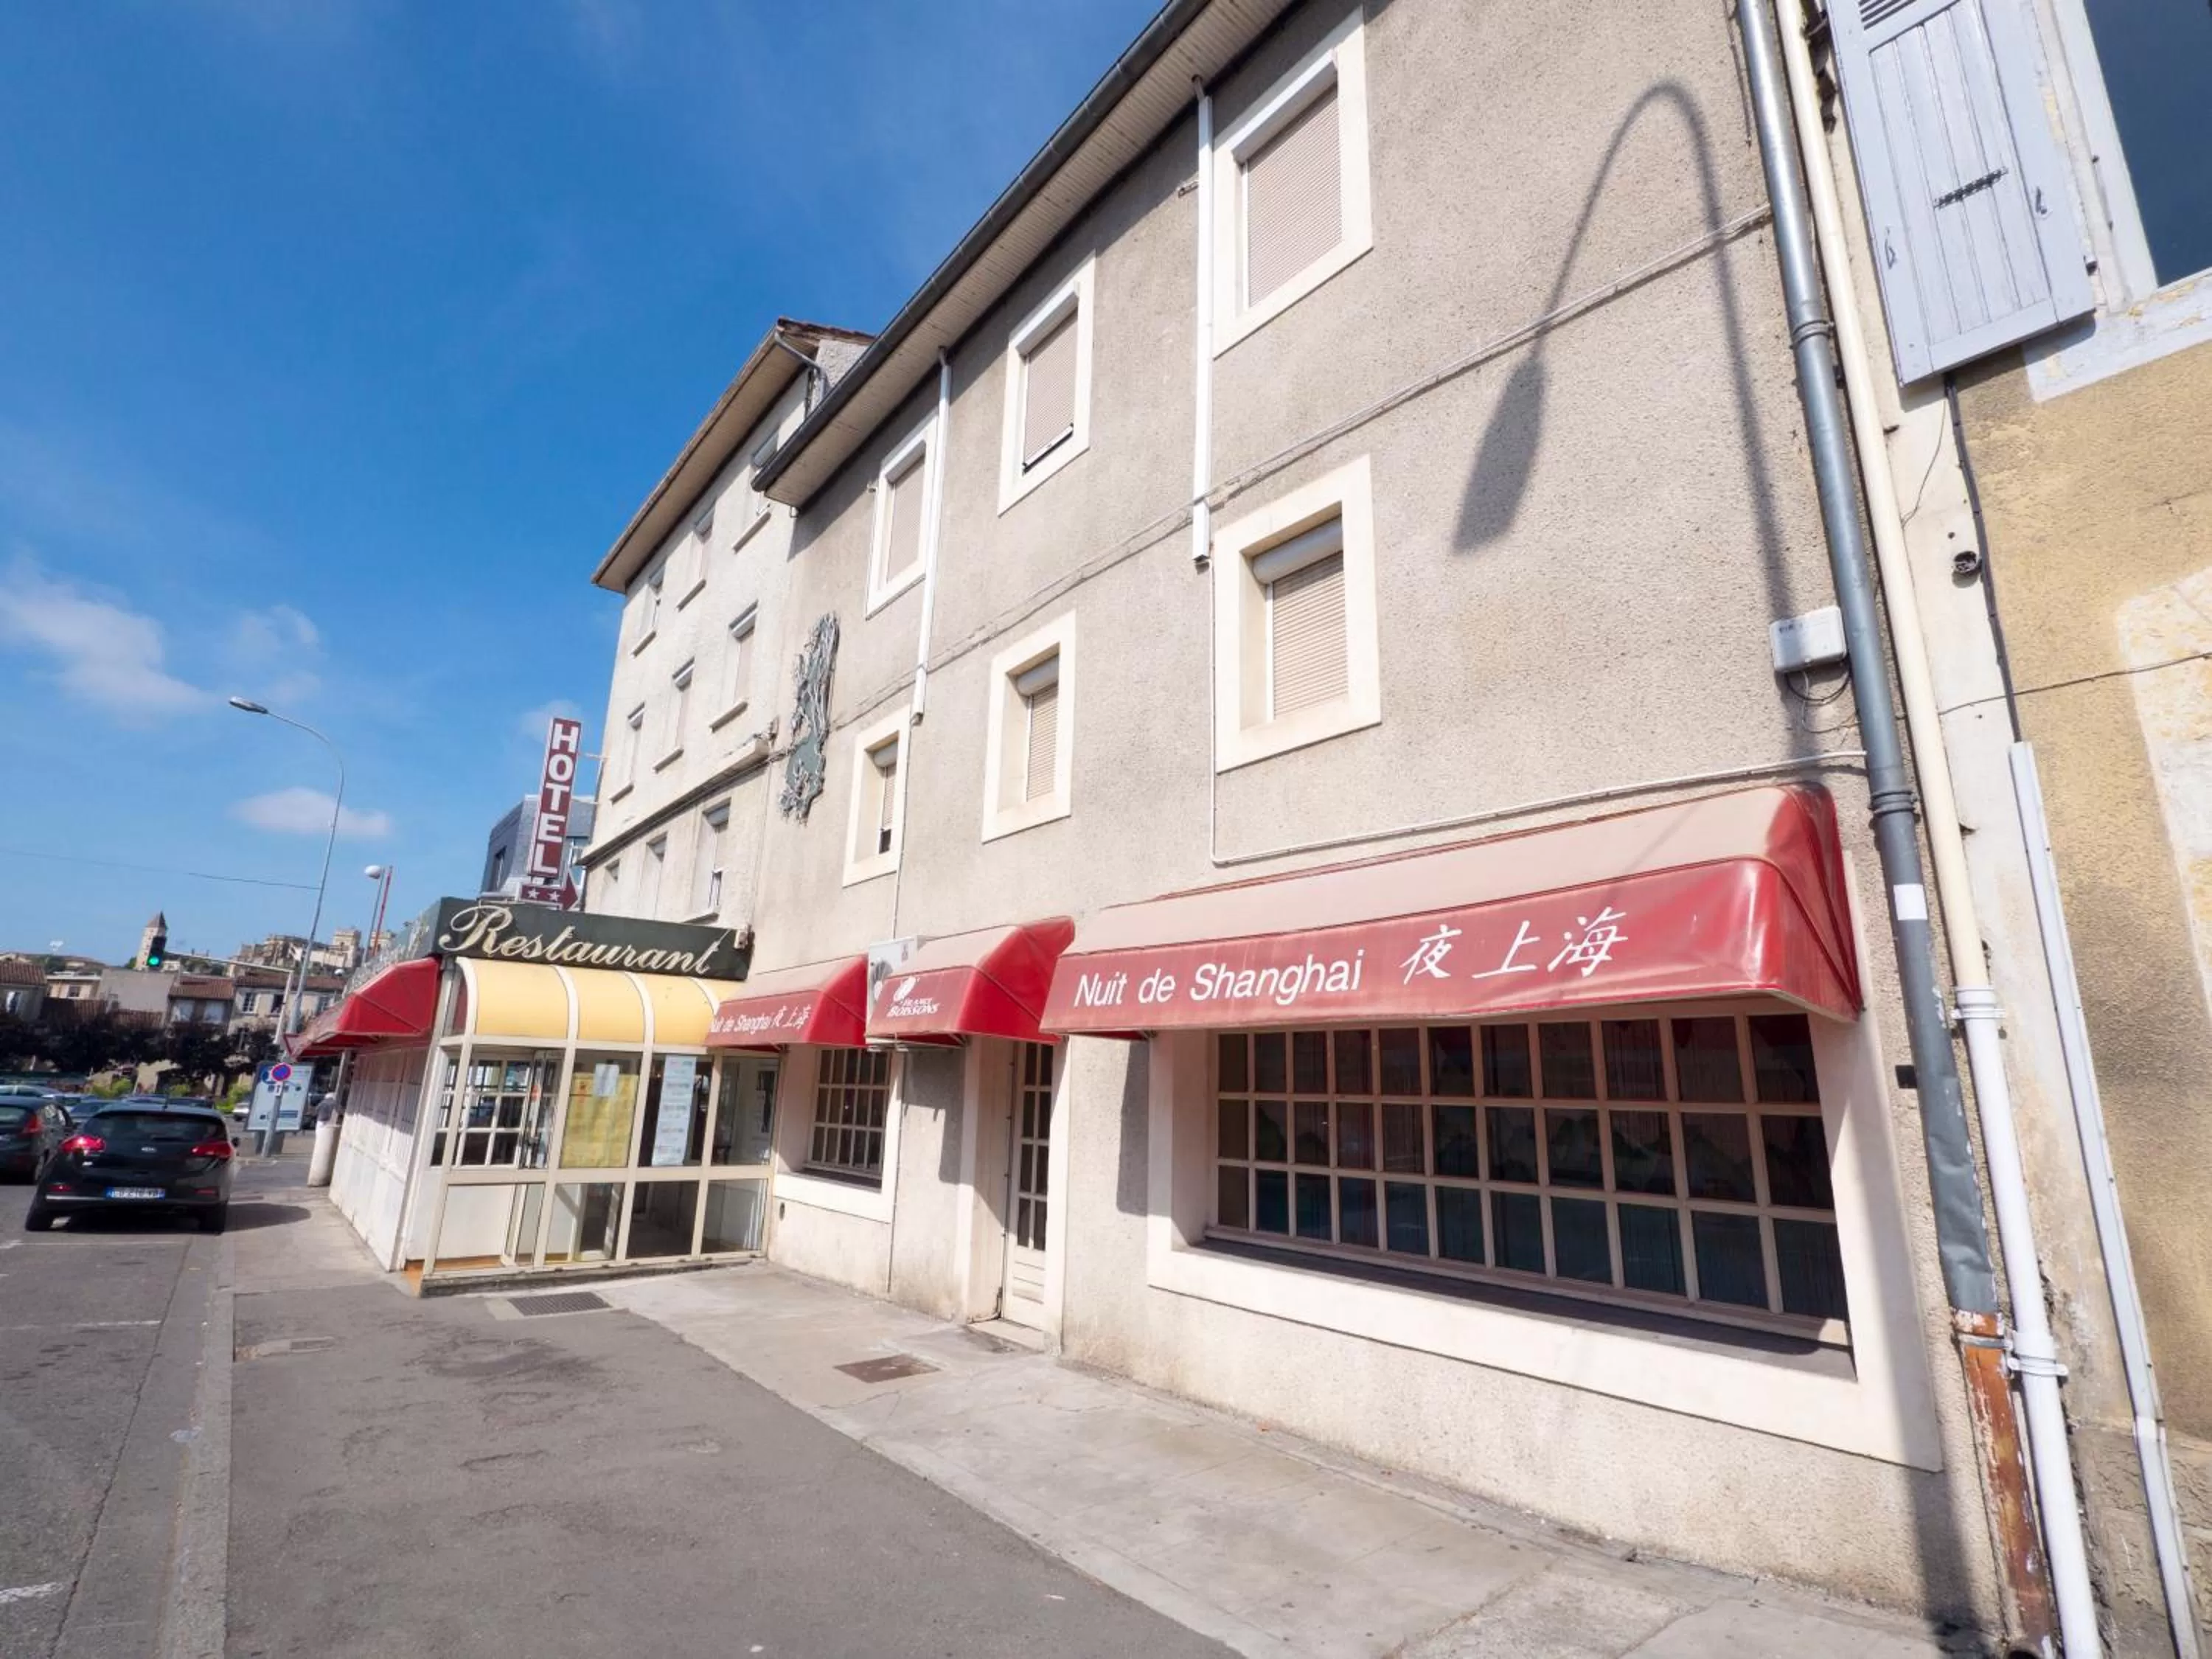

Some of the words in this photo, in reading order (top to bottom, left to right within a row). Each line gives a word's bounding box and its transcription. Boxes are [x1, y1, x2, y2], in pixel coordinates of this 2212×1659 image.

[533, 723, 579, 874] HOTEL
[439, 905, 720, 975] Restaurant
[1399, 906, 1629, 985] 夜上海
[1074, 971, 1127, 1008] Nuit
[1138, 967, 1176, 1004] de
[1190, 949, 1366, 1006] Shanghai
